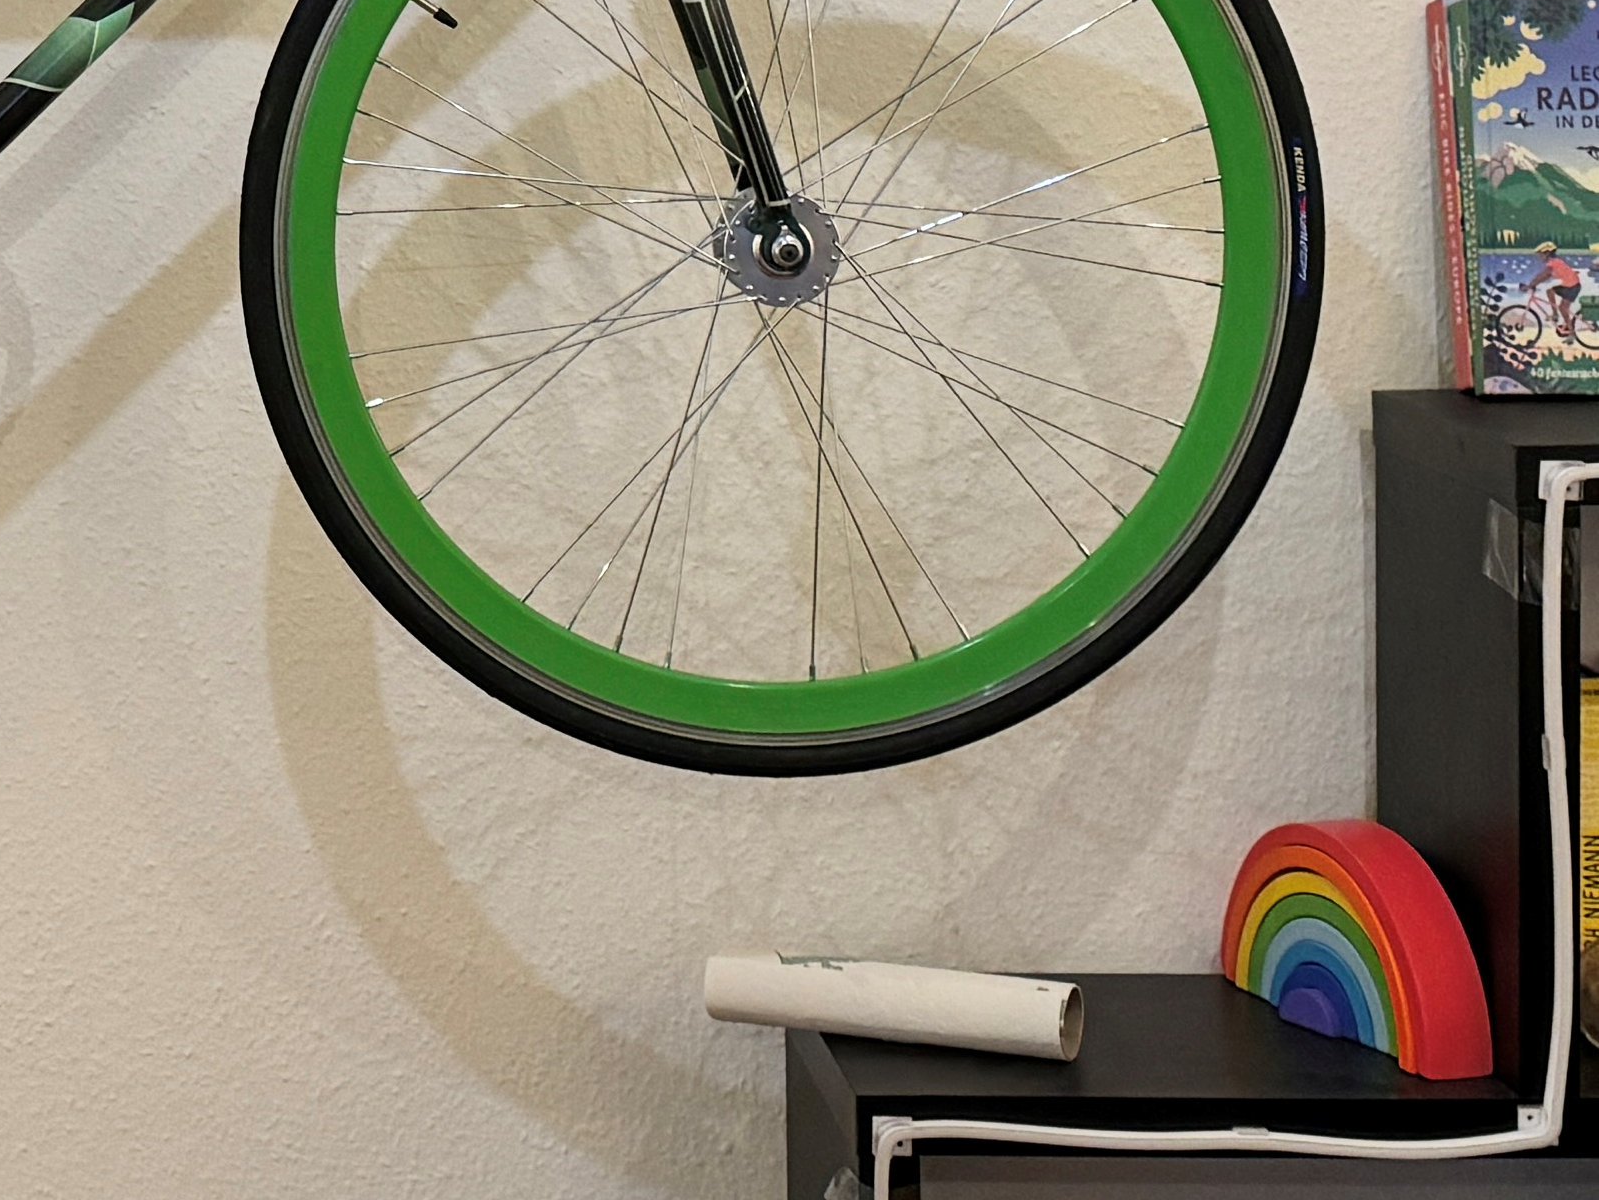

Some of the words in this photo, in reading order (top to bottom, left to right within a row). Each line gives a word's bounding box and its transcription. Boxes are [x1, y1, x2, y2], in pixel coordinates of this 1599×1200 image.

[1555, 115, 1574, 128] IN
[1293, 146, 1307, 193] KENDA
[1442, 138, 1451, 176] BIKE
[1451, 256, 1462, 324] EUROPE
